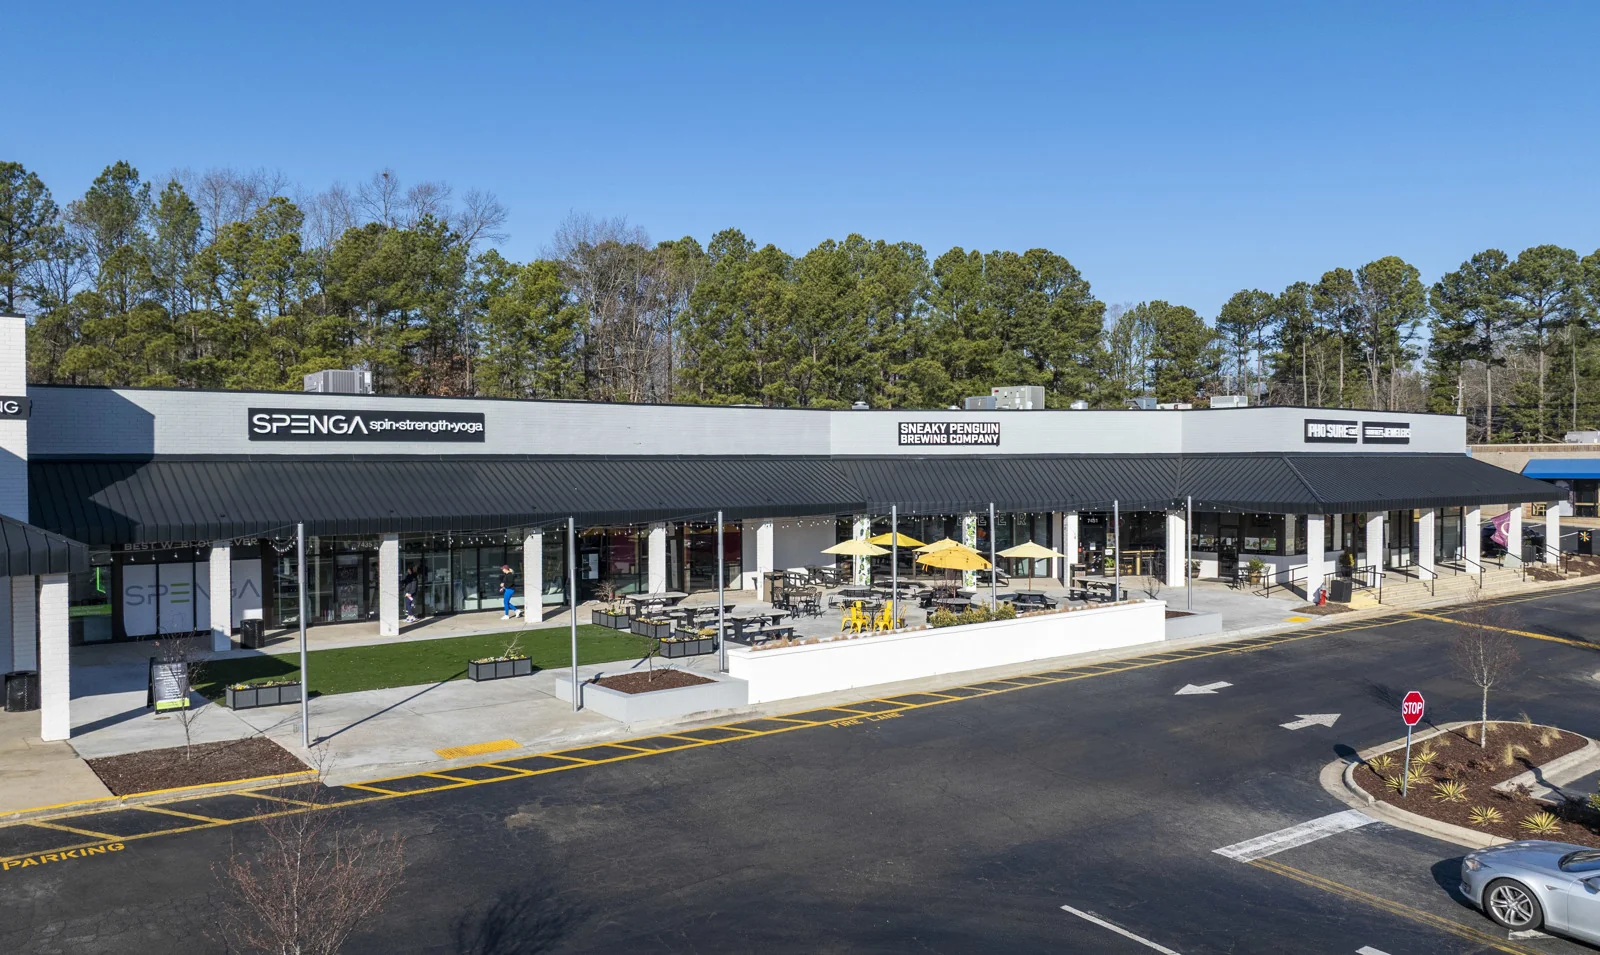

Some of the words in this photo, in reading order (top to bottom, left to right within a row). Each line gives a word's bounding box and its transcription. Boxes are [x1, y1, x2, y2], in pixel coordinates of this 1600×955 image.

[252, 413, 369, 434] SPENGA
[900, 423, 947, 433] SNEAKY
[949, 423, 999, 433] PENGUIN
[900, 434, 948, 444] BREWING
[949, 434, 999, 444] COMPANY
[124, 542, 157, 551] BEST
[1403, 701, 1423, 715] STOP
[829, 718, 864, 728] FIRE
[865, 712, 905, 722] LANE
[2, 843, 125, 871] PARKING
